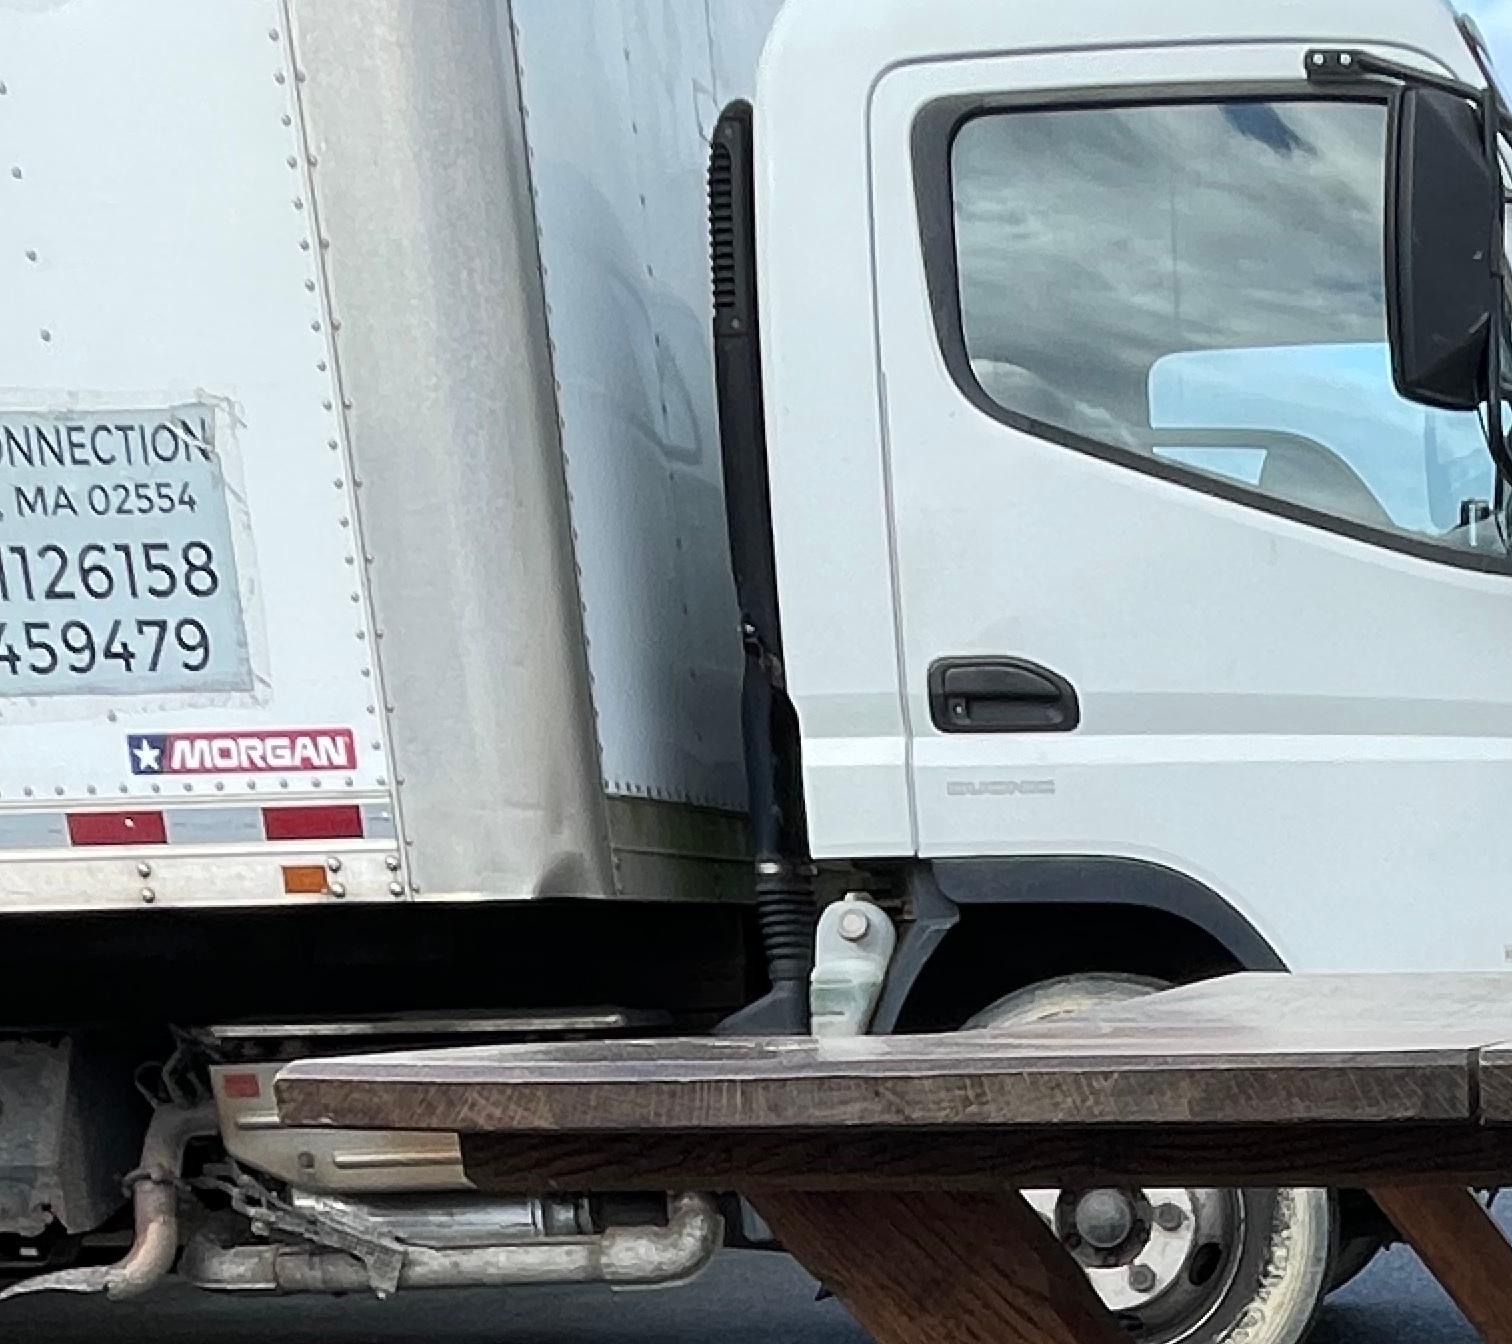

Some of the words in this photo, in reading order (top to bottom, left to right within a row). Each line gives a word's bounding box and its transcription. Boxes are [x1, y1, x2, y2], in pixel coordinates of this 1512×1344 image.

[0, 417, 212, 466] NNECTION
[14, 485, 78, 516] MA
[87, 481, 197, 515] 02554
[170, 736, 348, 770] MORGAN
